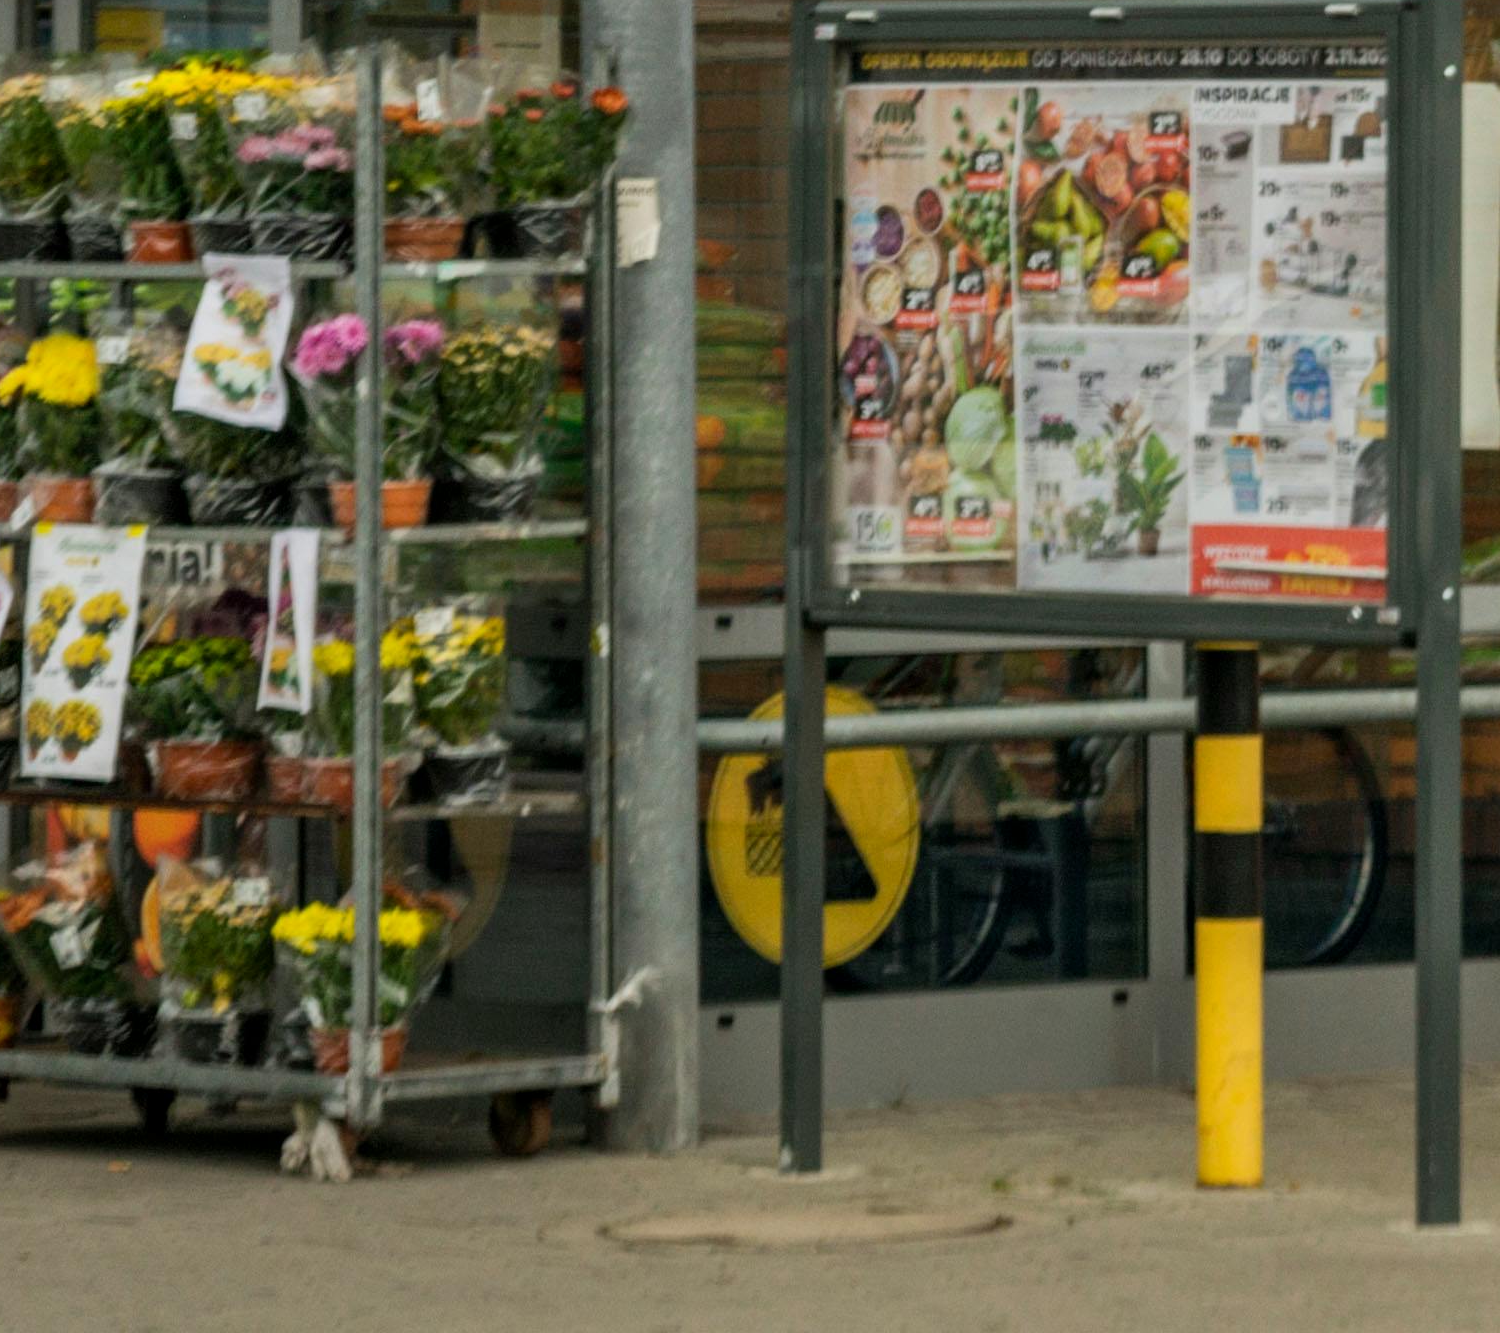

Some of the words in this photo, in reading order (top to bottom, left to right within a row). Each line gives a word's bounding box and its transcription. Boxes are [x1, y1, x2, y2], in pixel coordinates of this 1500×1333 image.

[1032, 51, 1055, 67] OD
[1179, 49, 1224, 66] 28.10
[1228, 49, 1250, 66] DO
[1256, 48, 1320, 66] SOBOTY
[1194, 86, 1291, 104] INSPIRACJE
